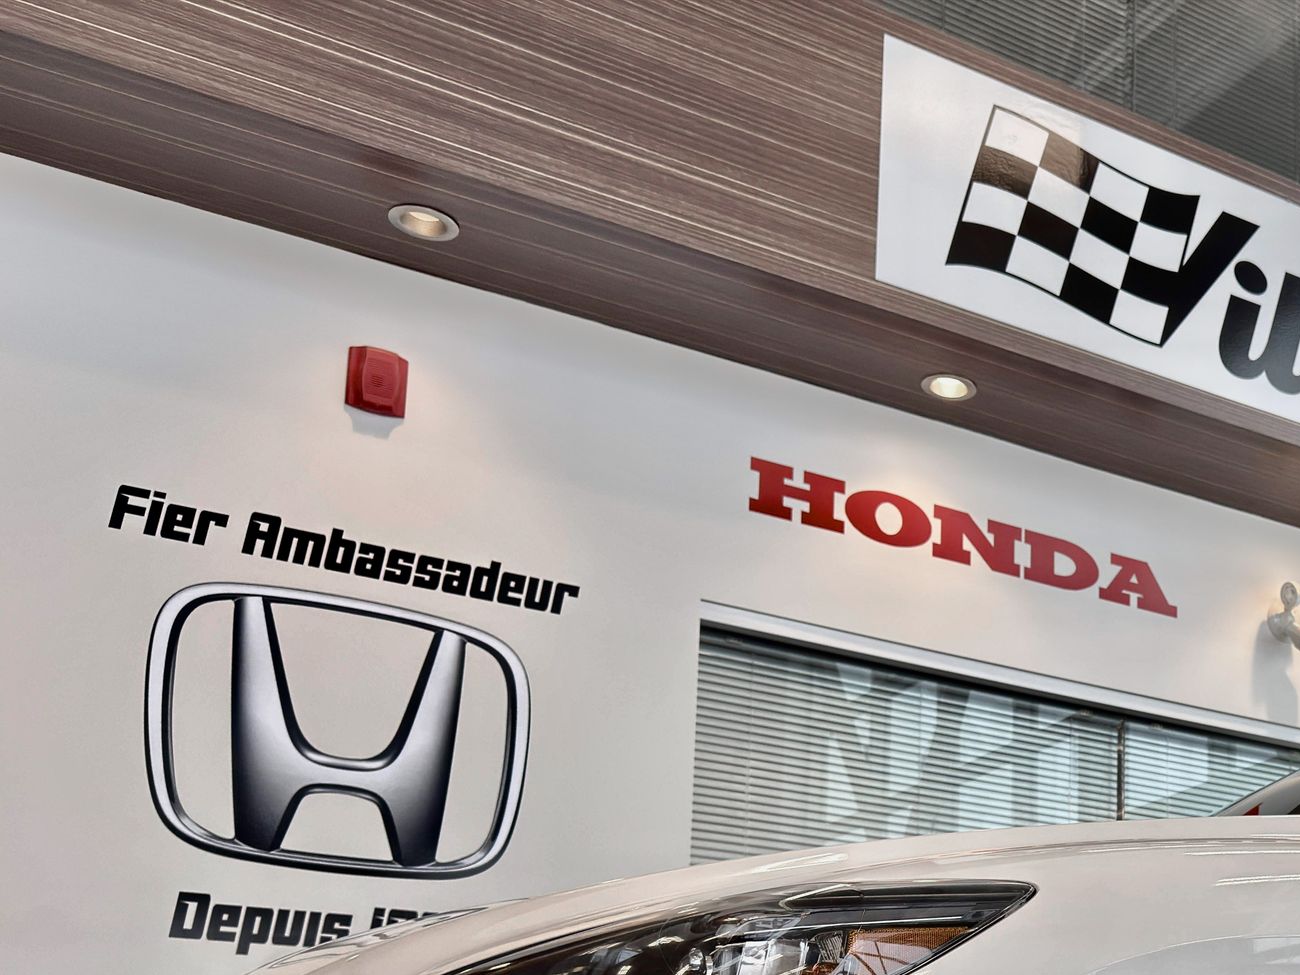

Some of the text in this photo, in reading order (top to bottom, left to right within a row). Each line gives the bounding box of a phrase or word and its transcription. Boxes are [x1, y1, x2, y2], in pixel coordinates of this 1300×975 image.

[107, 485, 580, 615] Fier Ambassadeur
[749, 457, 1178, 617] HONDA
[168, 891, 353, 955] Depuis
